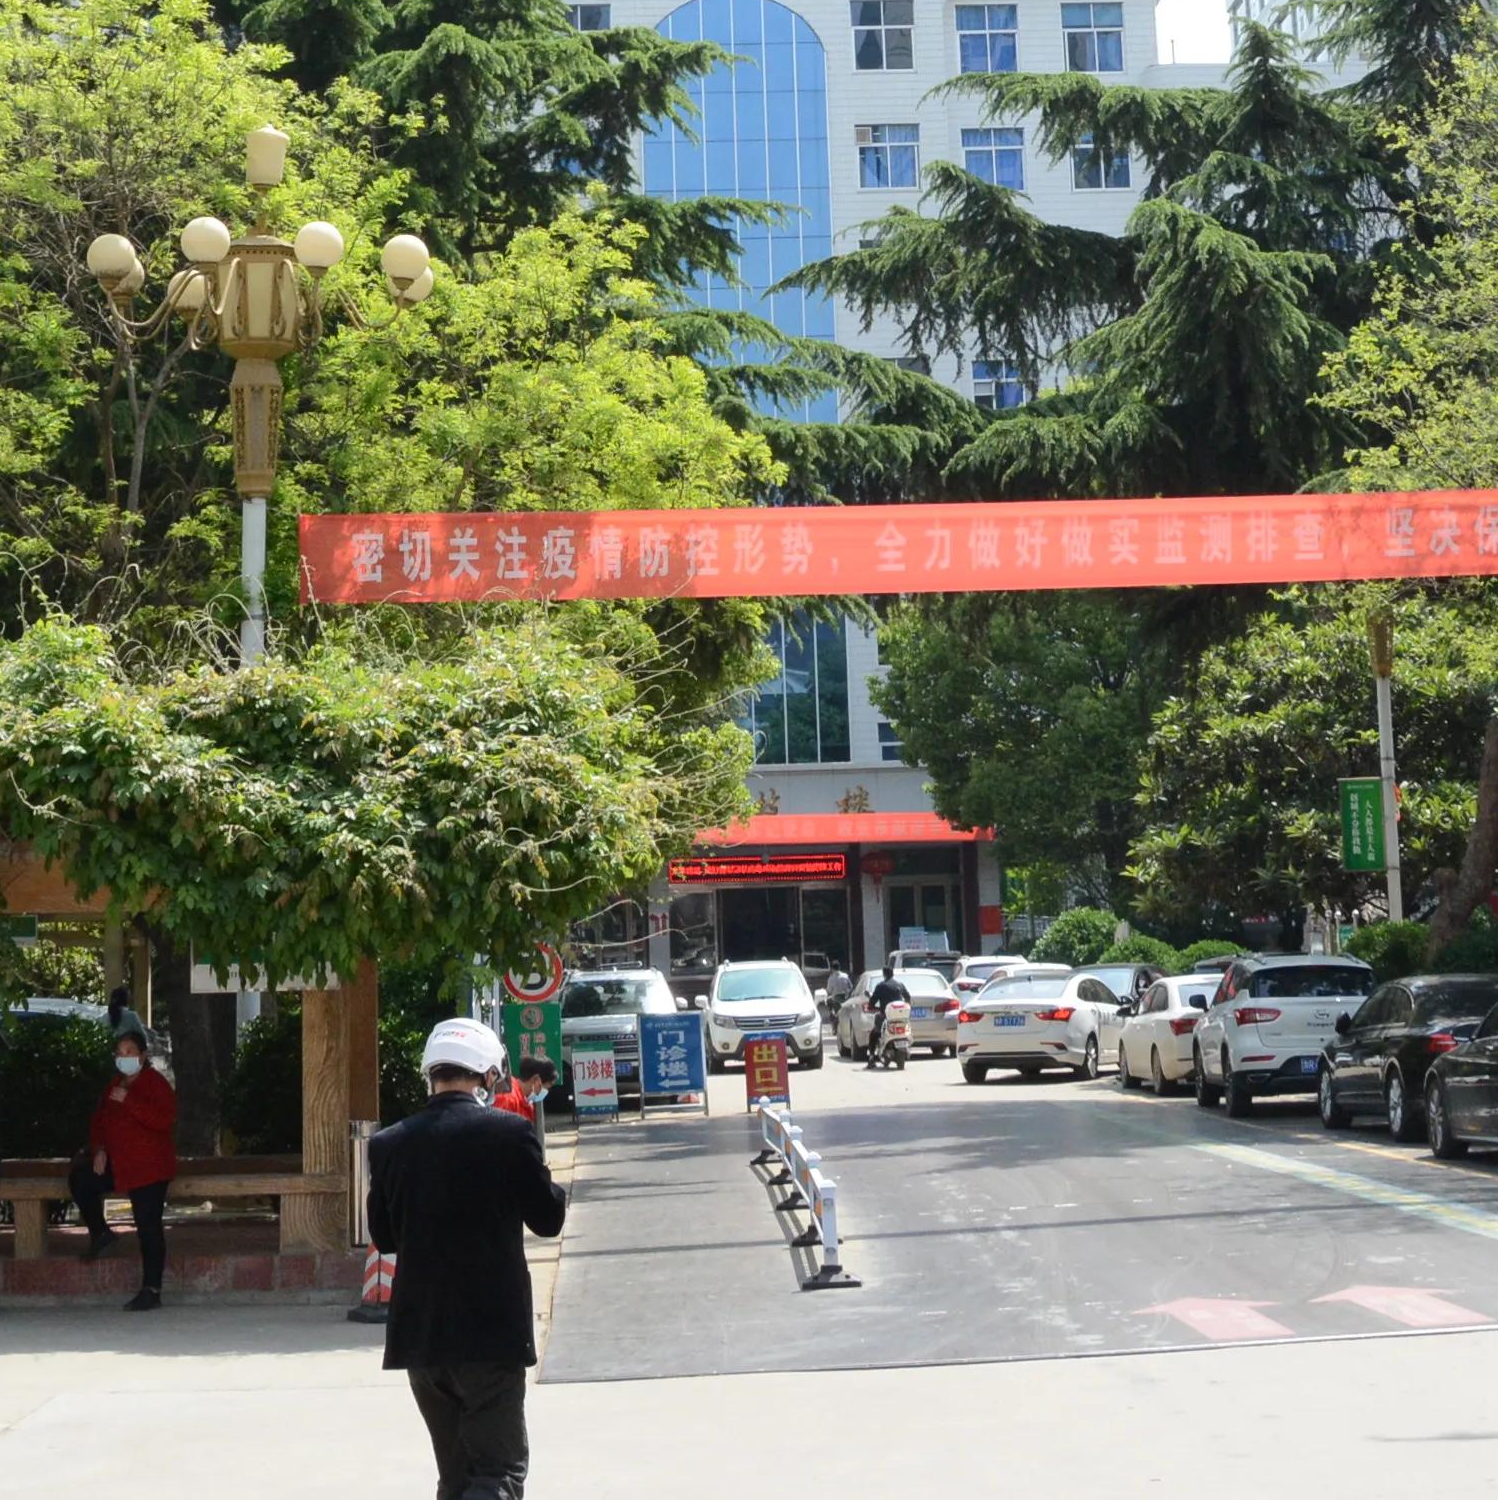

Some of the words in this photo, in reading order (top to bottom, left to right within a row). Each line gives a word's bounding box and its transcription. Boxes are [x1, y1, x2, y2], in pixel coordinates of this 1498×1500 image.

[573, 1060, 614, 1080] 门诊楼
[657, 1030, 689, 1077] 门诊楼
[753, 1044, 779, 1084] 出口
